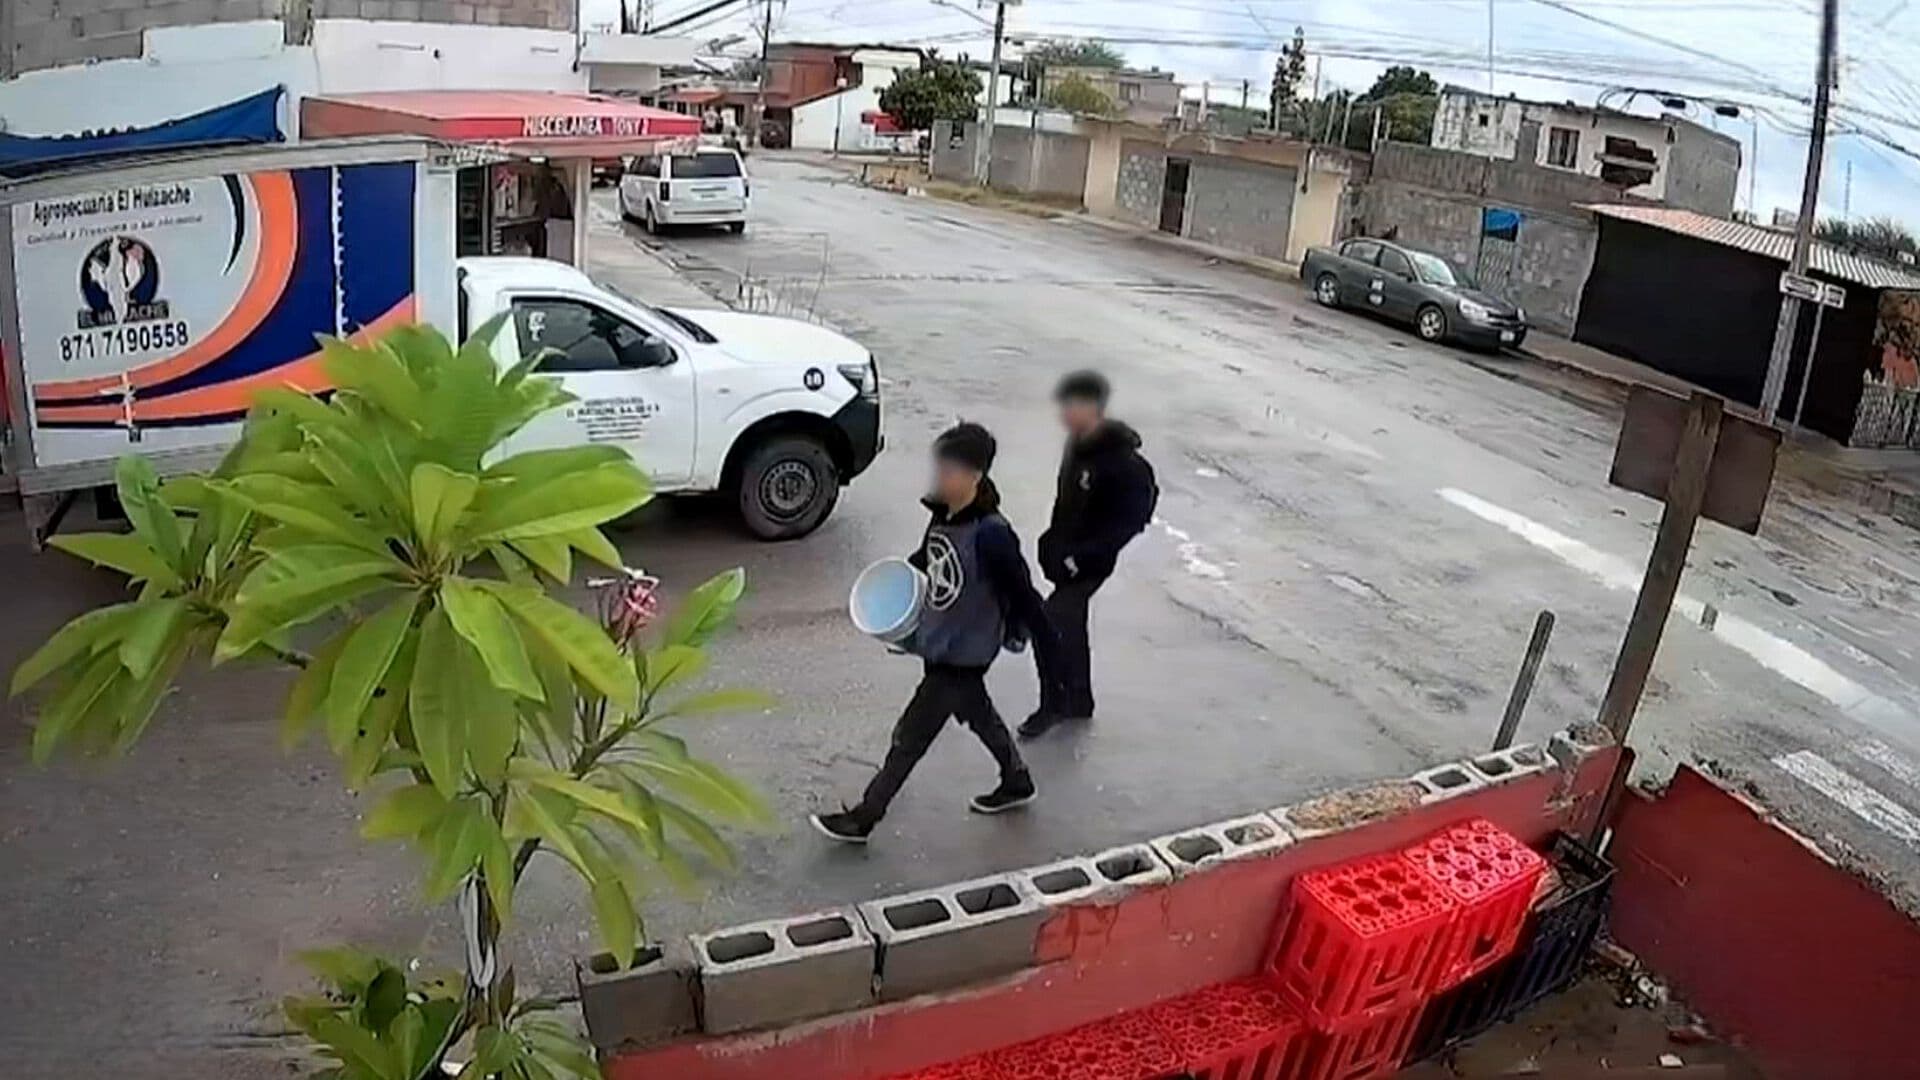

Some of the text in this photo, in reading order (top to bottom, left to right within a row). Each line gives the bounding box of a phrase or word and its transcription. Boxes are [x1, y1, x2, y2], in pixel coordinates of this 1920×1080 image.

[34, 195, 115, 226] Agropecuaria
[118, 190, 129, 211] El
[60, 321, 189, 361] 871 7190558
